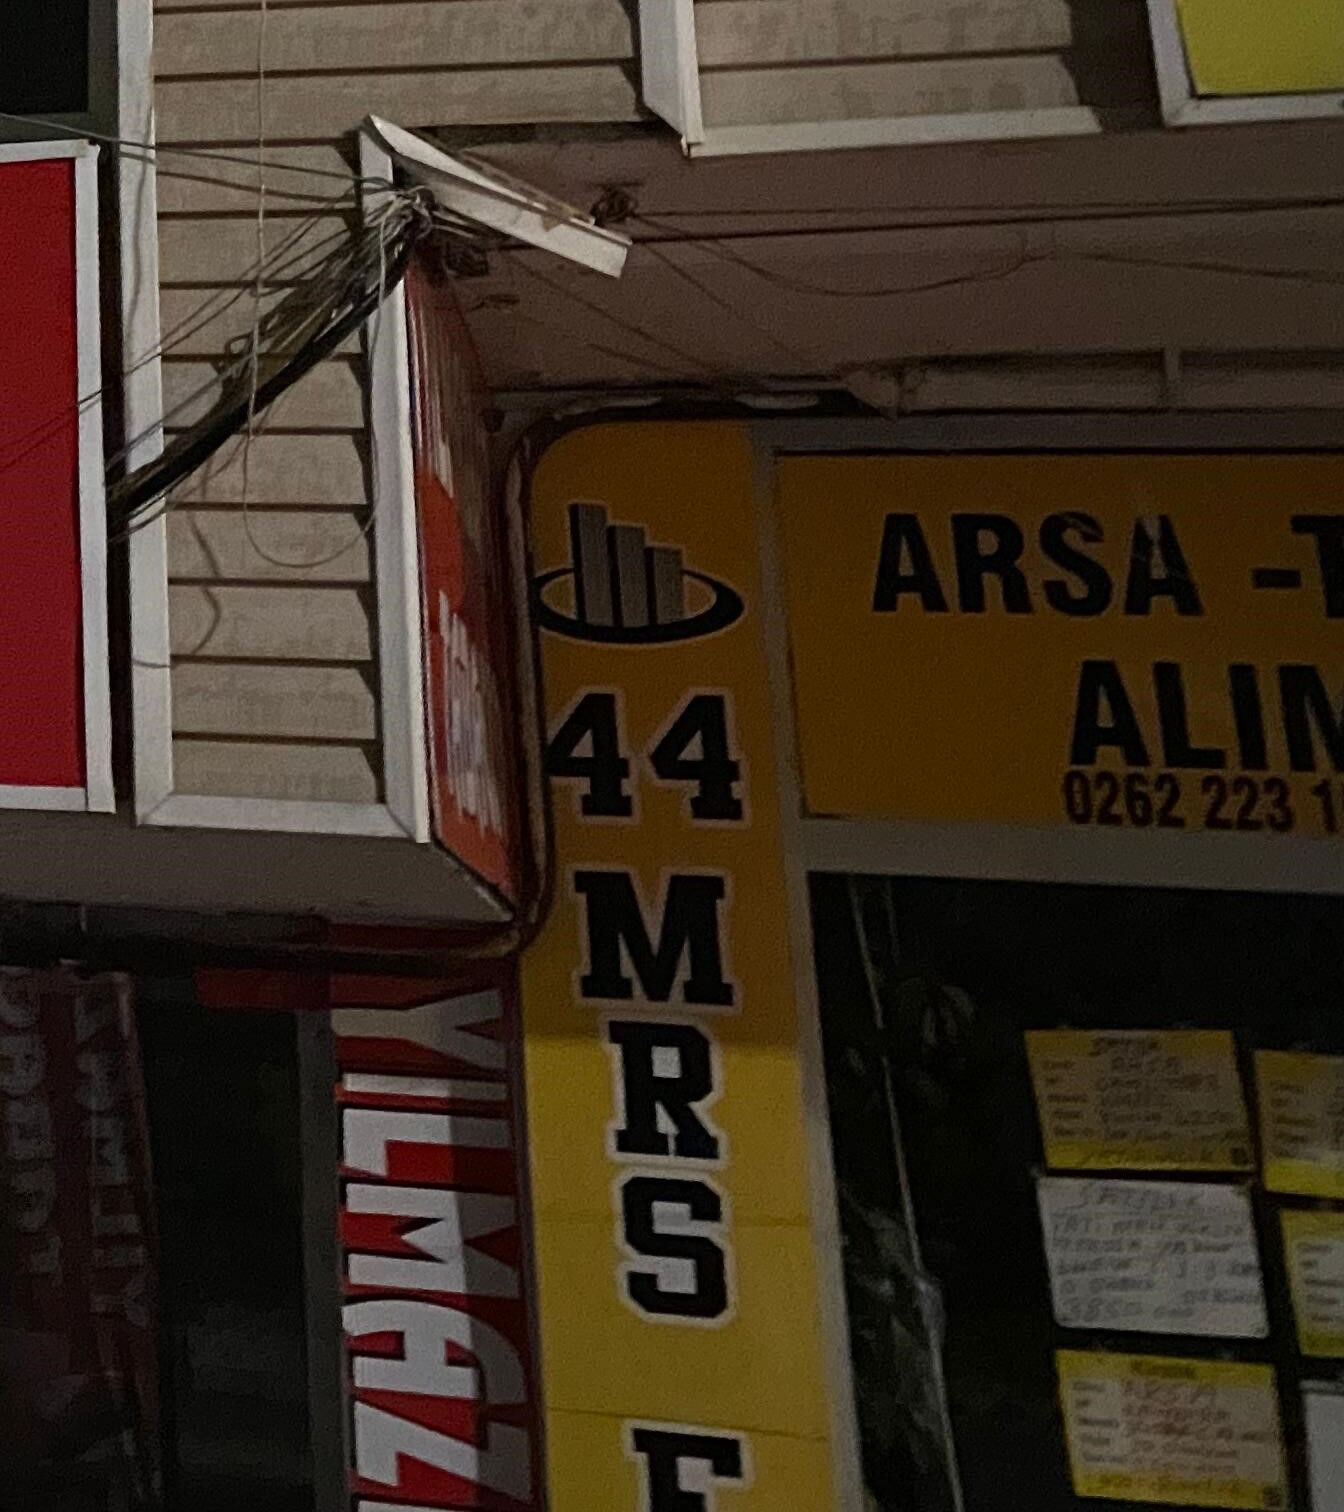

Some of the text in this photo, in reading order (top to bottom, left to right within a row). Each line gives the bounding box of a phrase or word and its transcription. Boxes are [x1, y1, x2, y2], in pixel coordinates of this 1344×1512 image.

[872, 512, 1205, 617] ARSA
[547, 692, 744, 820] 44
[1063, 770, 1187, 829] 0262
[1200, 776, 1295, 833] 223
[331, 988, 538, 1512] YILMAZ
